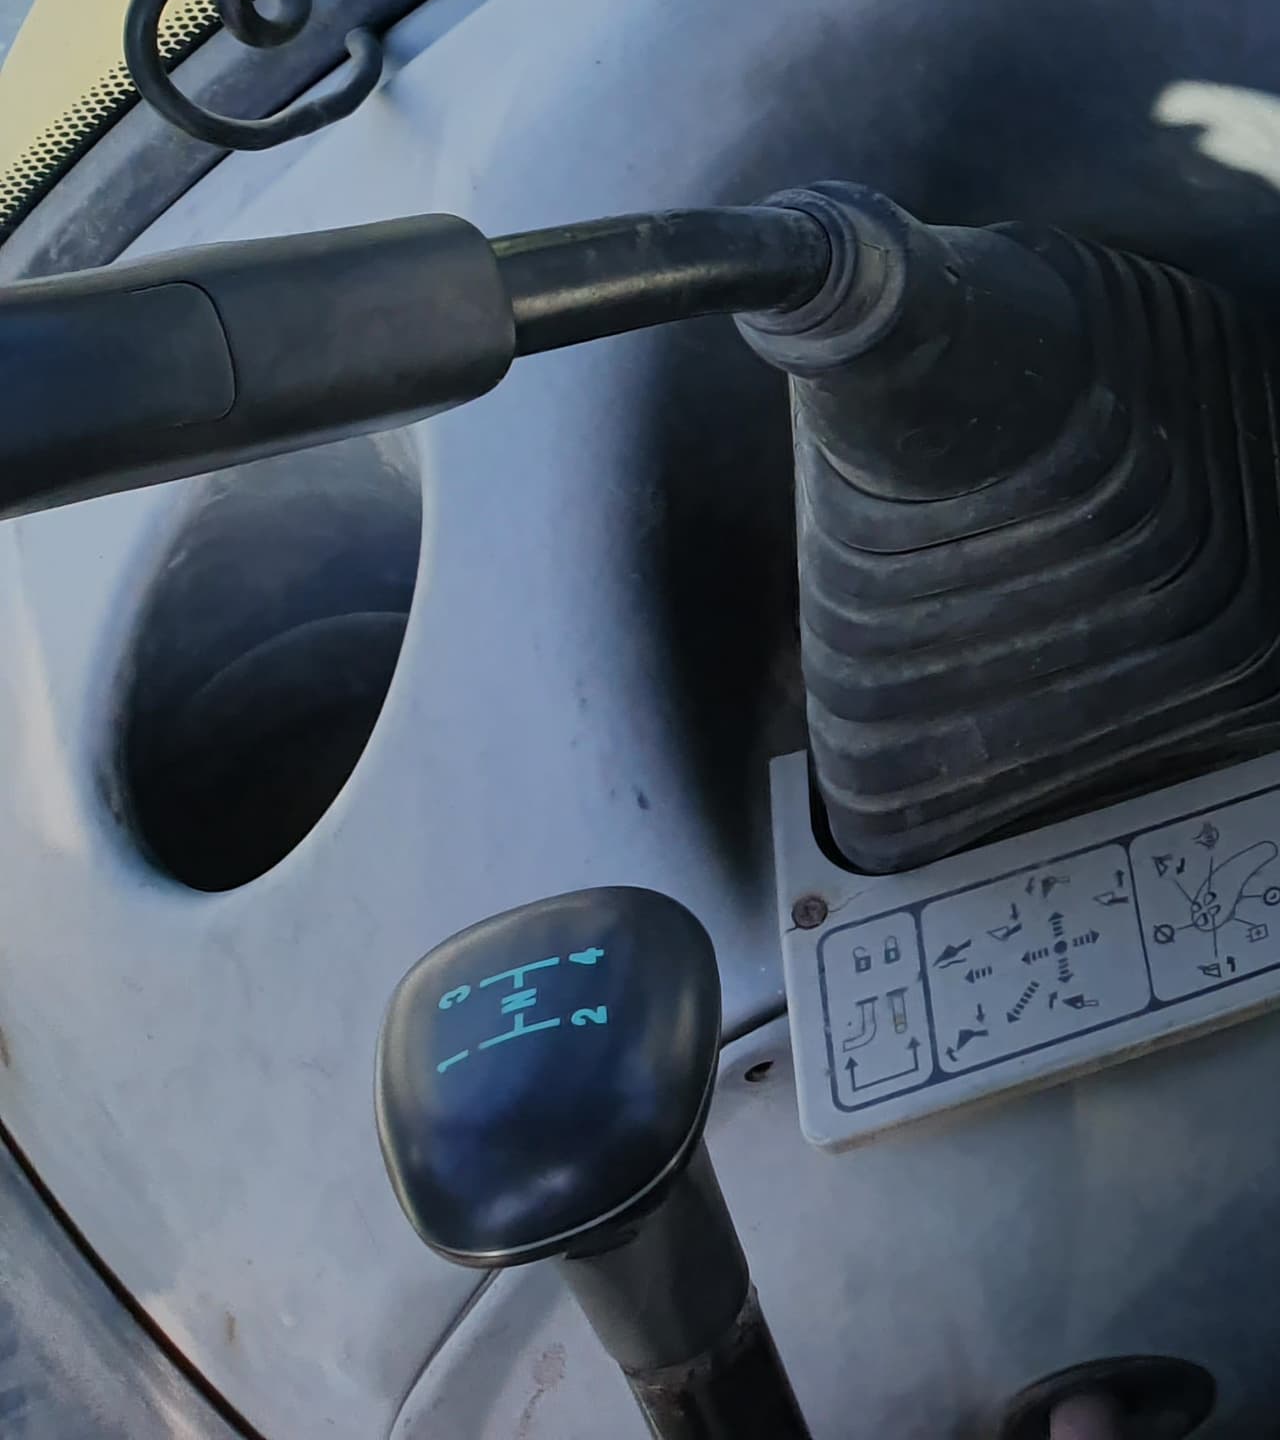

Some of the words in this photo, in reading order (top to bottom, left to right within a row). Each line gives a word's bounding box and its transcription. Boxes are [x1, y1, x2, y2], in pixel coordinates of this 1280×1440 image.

[569, 947, 604, 965] 4
[438, 984, 471, 1009] 3
[502, 988, 537, 1013] N
[571, 1006, 608, 1025] 2
[437, 1049, 469, 1073] 1
